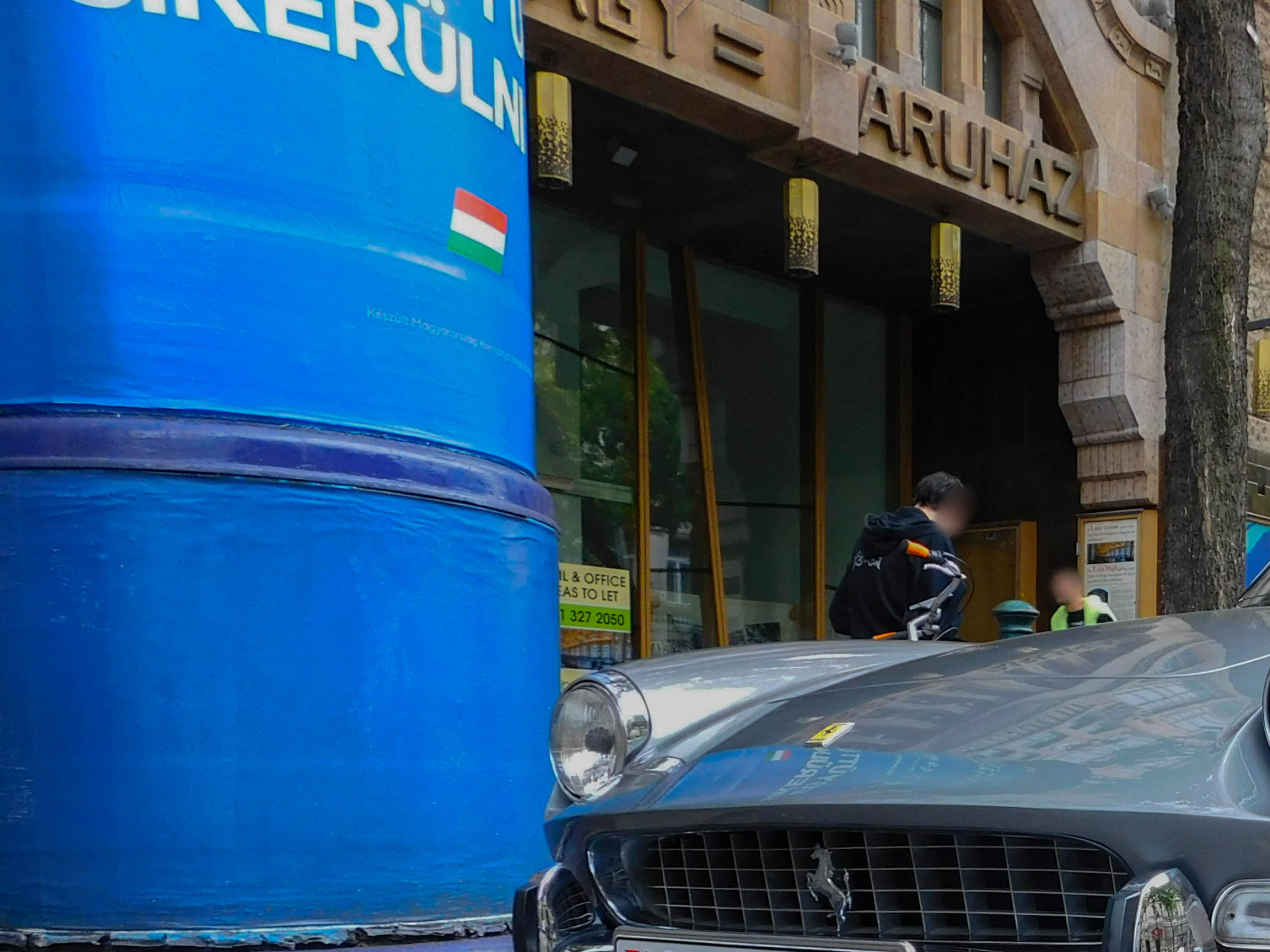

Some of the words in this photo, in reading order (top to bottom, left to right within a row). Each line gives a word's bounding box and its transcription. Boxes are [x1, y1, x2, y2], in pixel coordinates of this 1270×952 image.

[859, 65, 1082, 226] ÁRUHÁZ
[584, 573, 626, 588] OFFICE
[581, 587, 597, 600] TO
[602, 590, 618, 602] LET
[570, 610, 591, 623] 327
[596, 612, 624, 626] 2050
